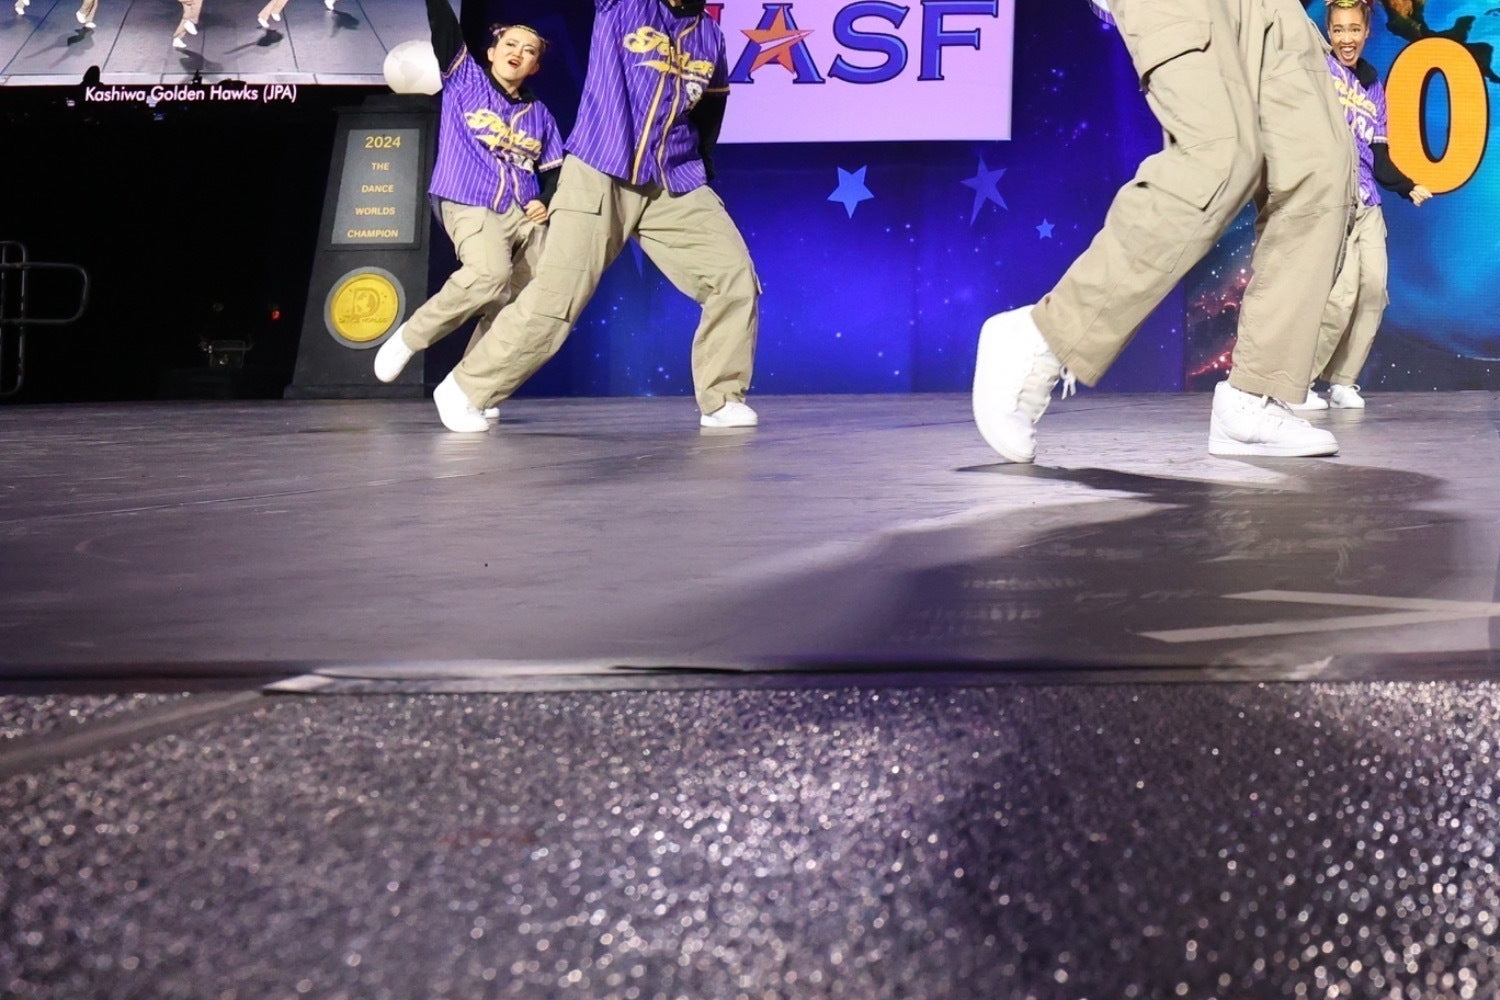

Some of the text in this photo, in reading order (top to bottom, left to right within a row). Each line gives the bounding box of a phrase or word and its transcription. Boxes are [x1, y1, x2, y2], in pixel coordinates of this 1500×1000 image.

[85, 84, 297, 103] Kashiwa Golden Hawks (JPA)
[365, 136, 401, 149] 2024
[372, 162, 390, 170] THE
[362, 185, 395, 193] DANCE
[355, 207, 396, 216] WORLDS
[347, 229, 399, 238] CHAMPION
